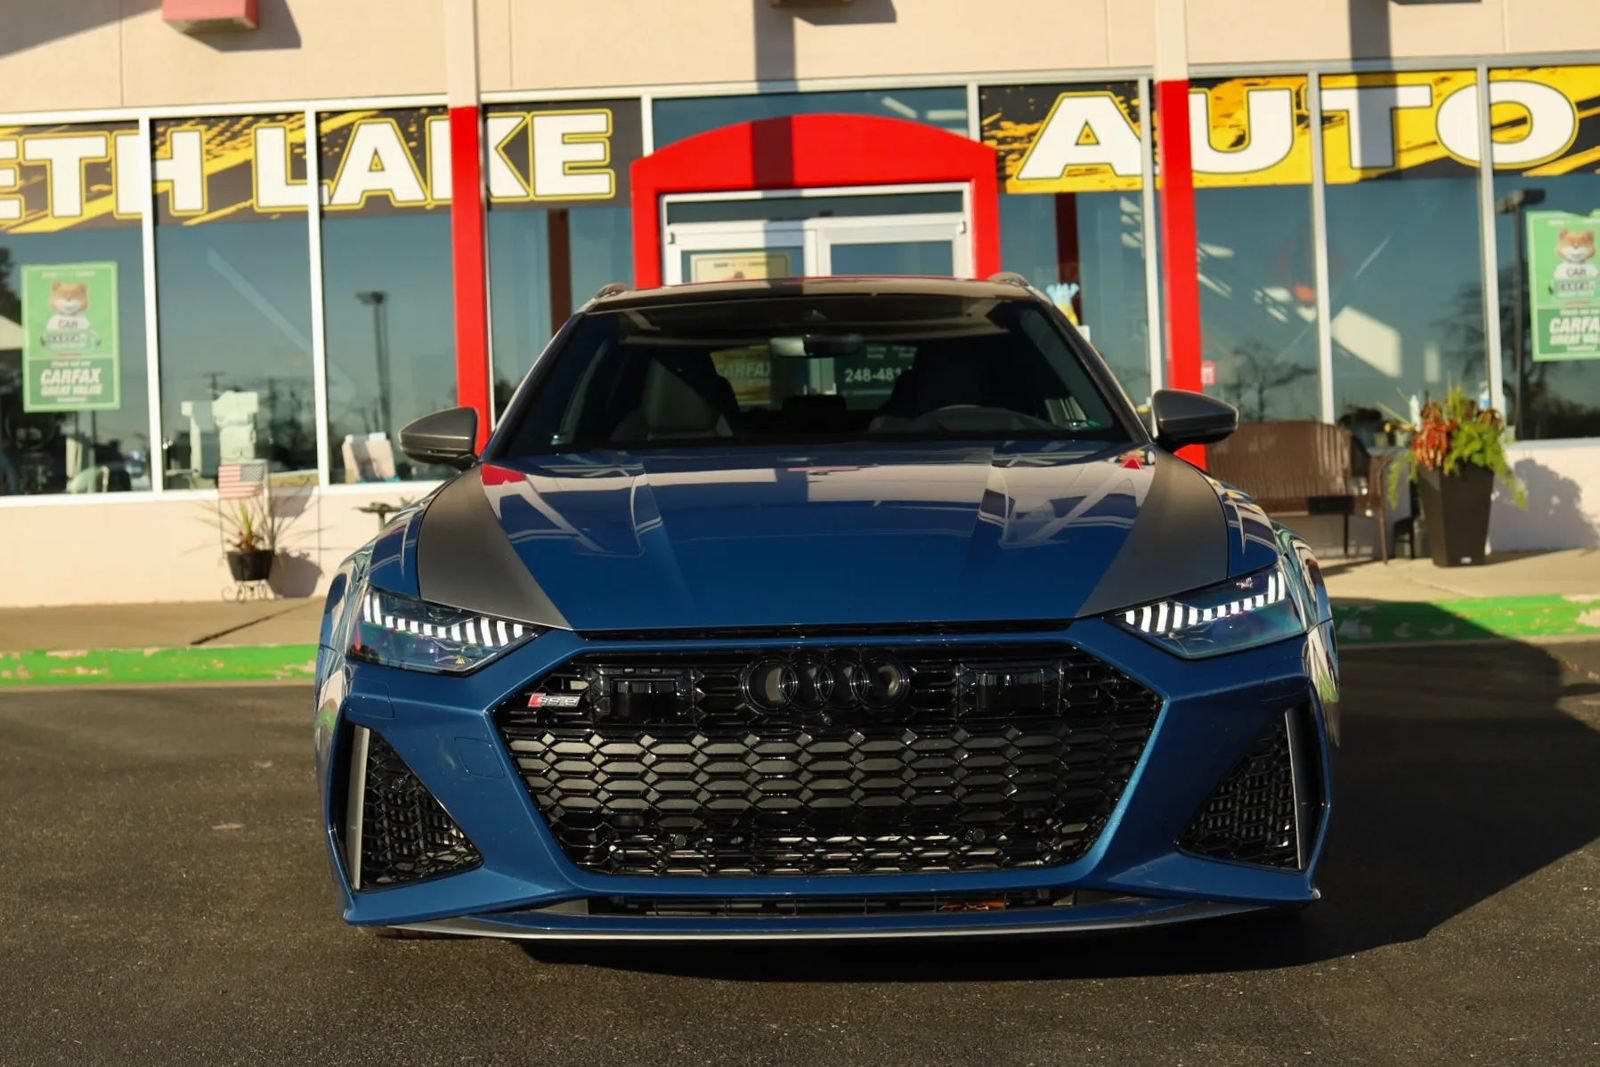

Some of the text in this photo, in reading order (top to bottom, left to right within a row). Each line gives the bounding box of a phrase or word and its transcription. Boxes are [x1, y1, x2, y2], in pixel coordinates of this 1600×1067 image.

[253, 108, 616, 212] LAKE
[1012, 80, 1579, 183] AUTO
[40, 367, 102, 385] CARFAX
